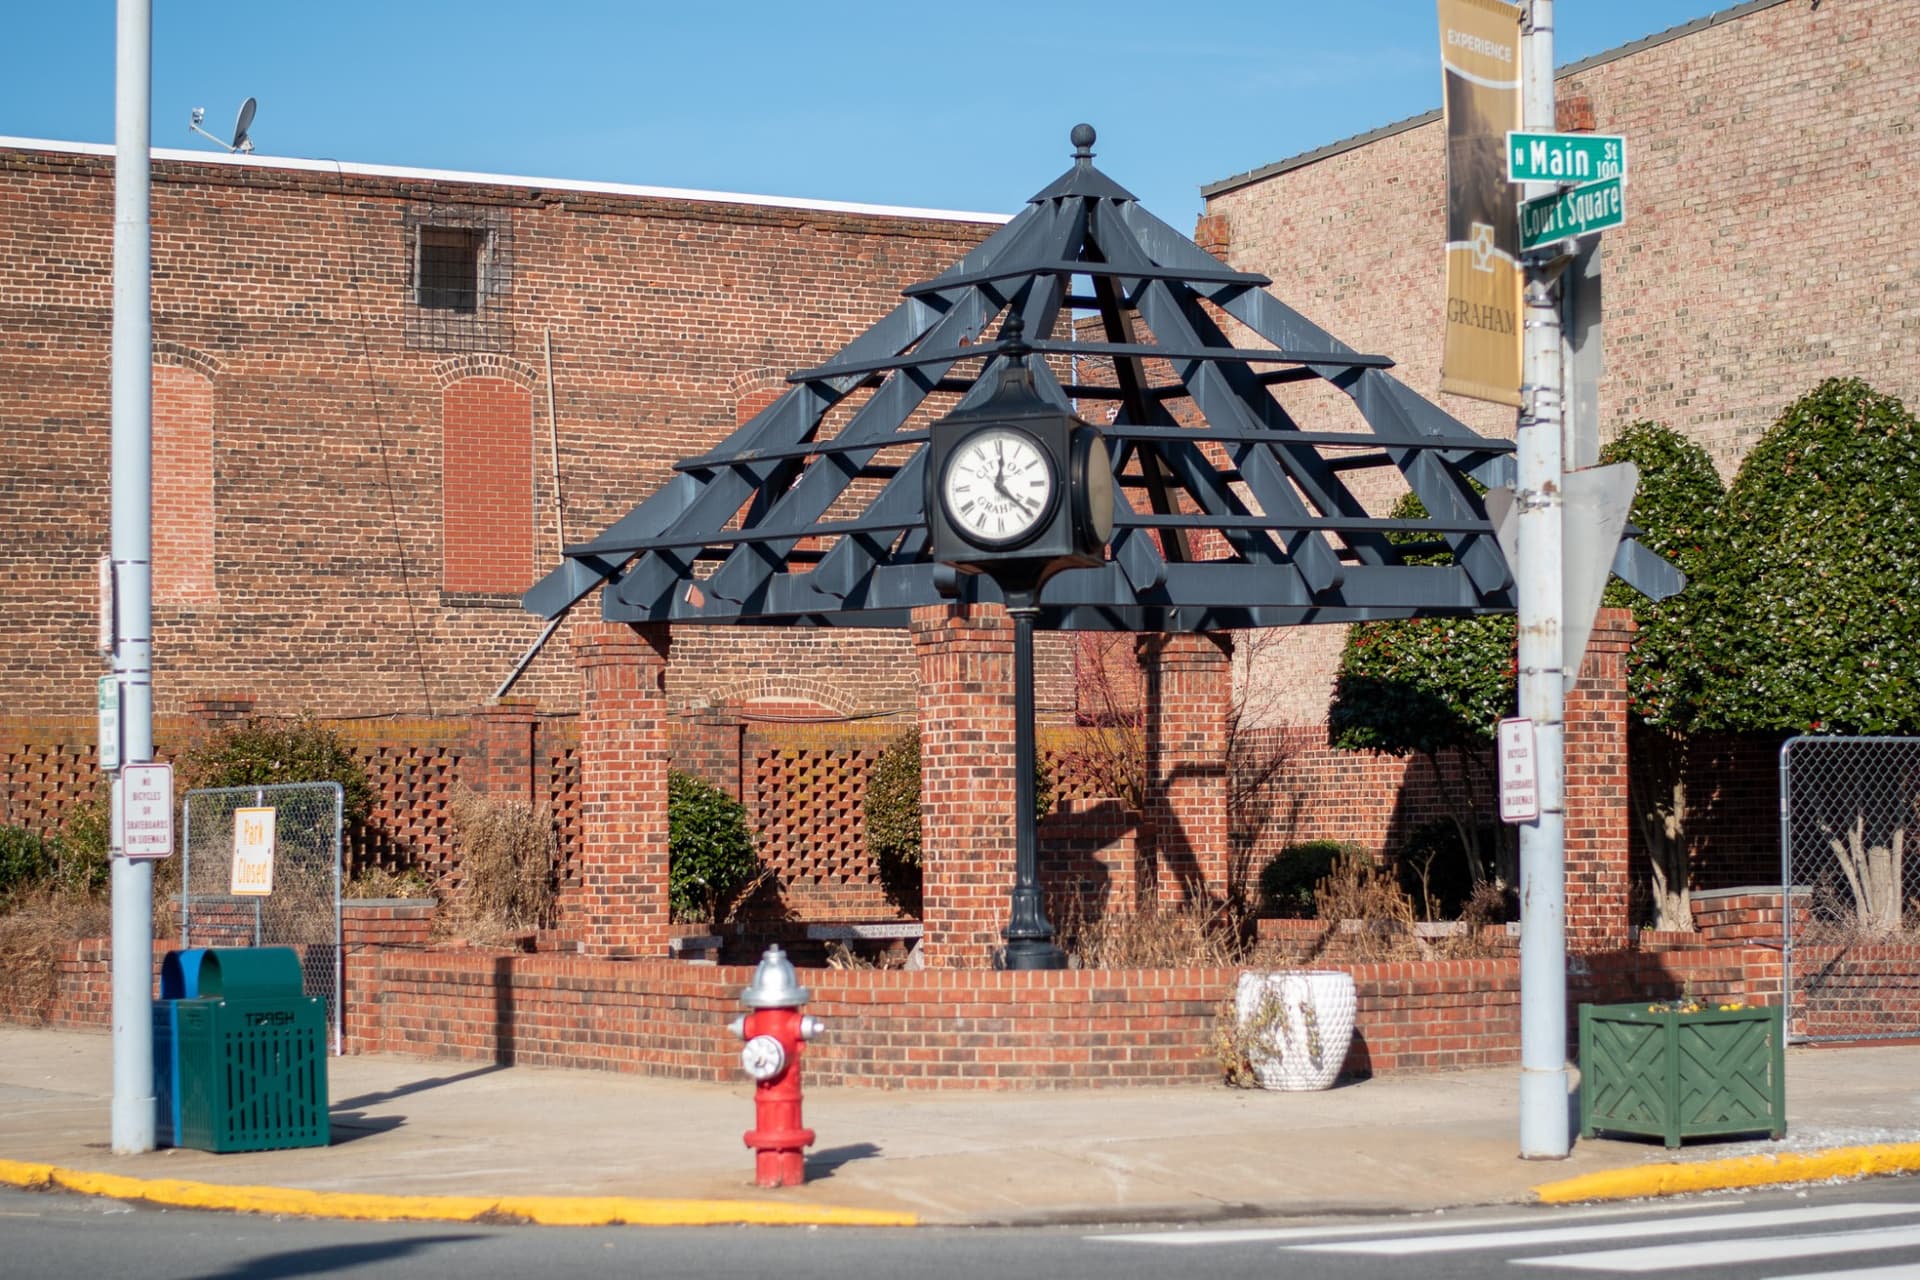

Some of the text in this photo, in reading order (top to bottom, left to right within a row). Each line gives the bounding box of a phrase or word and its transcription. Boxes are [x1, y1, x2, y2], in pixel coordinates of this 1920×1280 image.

[1447, 28, 1512, 64] EXPERIENCE
[1515, 140, 1618, 176] N Main St
[1596, 161, 1619, 178] 100
[1523, 186, 1619, 237] Court Square
[1447, 297, 1516, 336] GRAHAM
[243, 818, 263, 846] Park
[238, 857, 267, 884] Closed
[245, 1011, 295, 1027] TRASH
